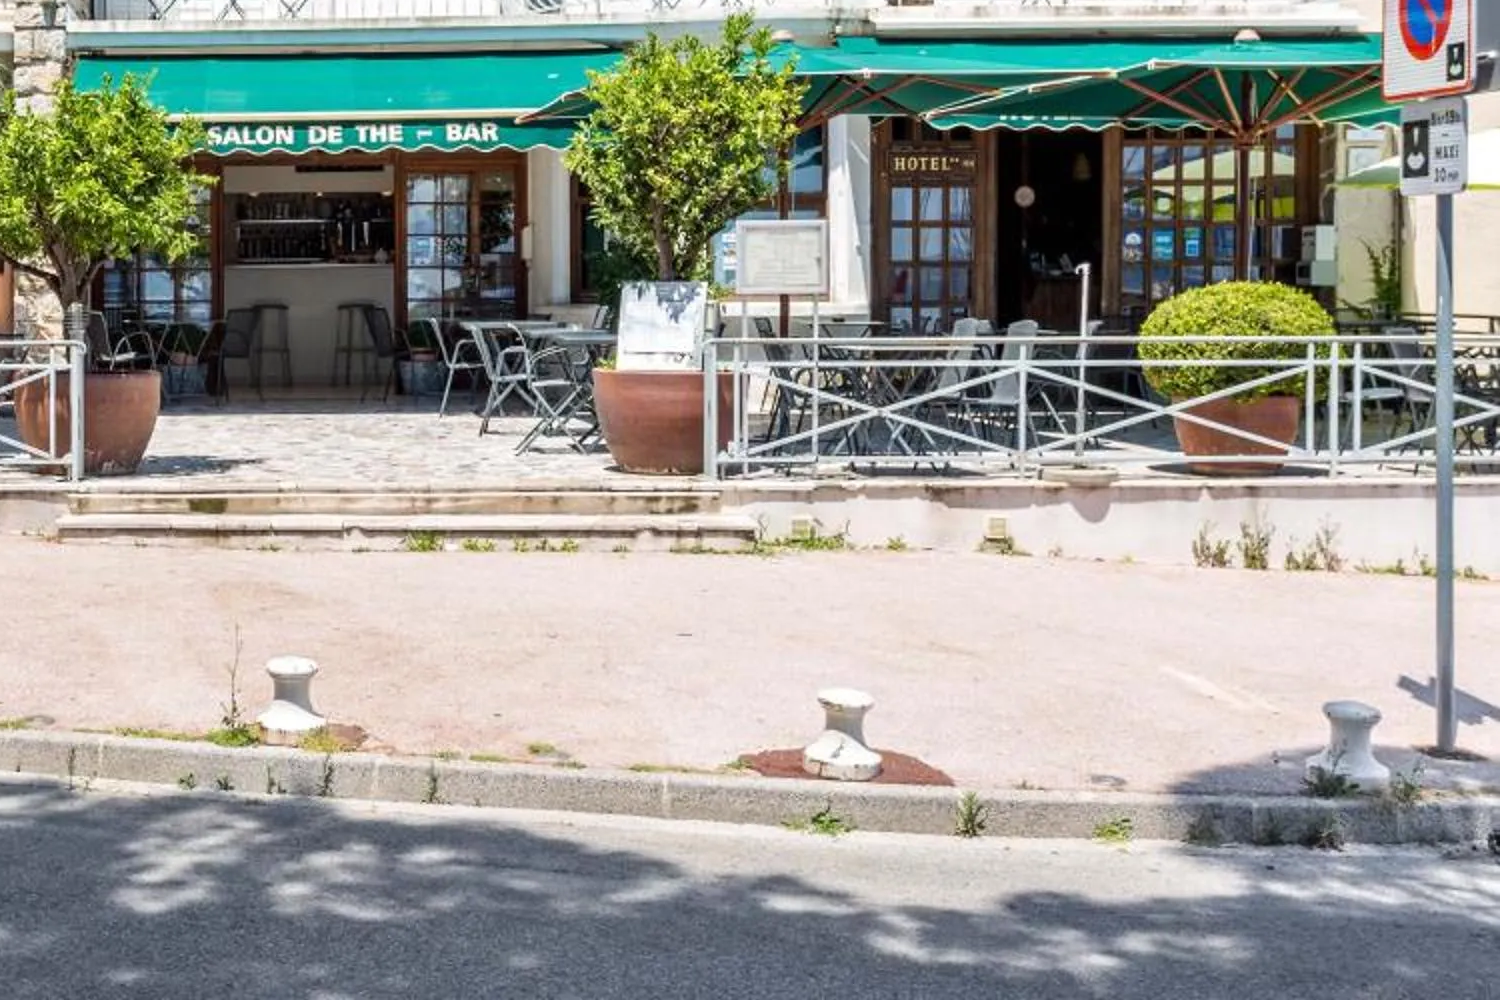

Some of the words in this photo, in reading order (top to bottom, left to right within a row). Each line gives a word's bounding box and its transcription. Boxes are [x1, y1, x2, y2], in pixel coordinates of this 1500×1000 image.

[207, 125, 294, 145] SALON
[308, 125, 343, 144] DE
[355, 124, 404, 143] THE
[446, 123, 498, 141] BAR
[894, 157, 951, 171] HOTEL
